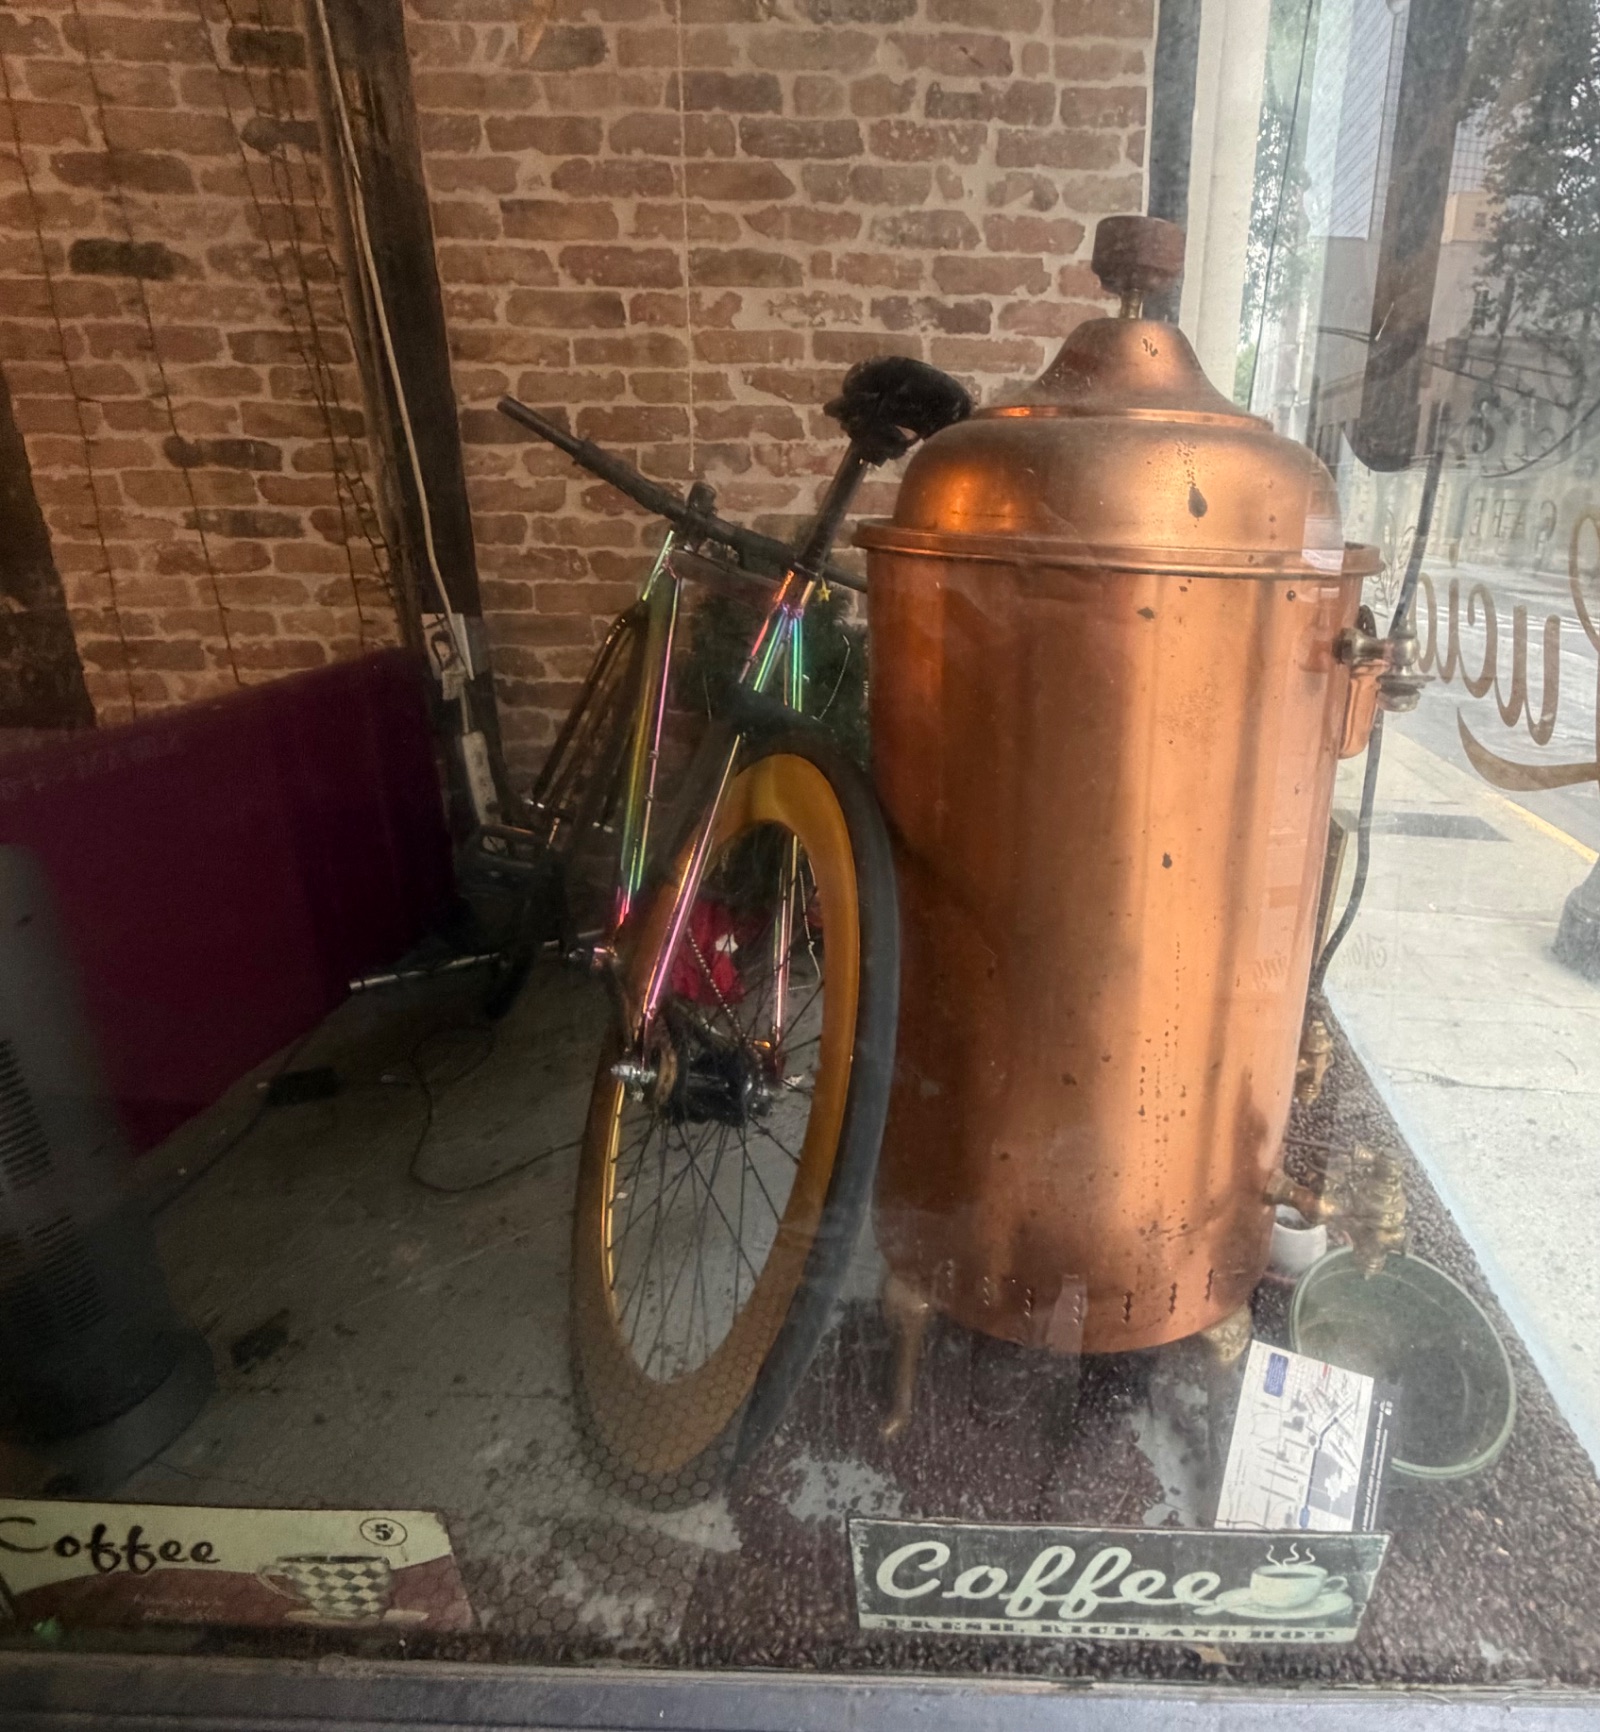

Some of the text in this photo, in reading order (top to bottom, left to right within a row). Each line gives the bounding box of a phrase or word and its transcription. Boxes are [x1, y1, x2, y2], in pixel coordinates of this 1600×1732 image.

[0, 1516, 221, 1575] Coffee
[876, 1540, 1224, 1620] Coffee
[1162, 1627, 1238, 1638] AND
[1249, 1629, 1336, 1639] HOT
